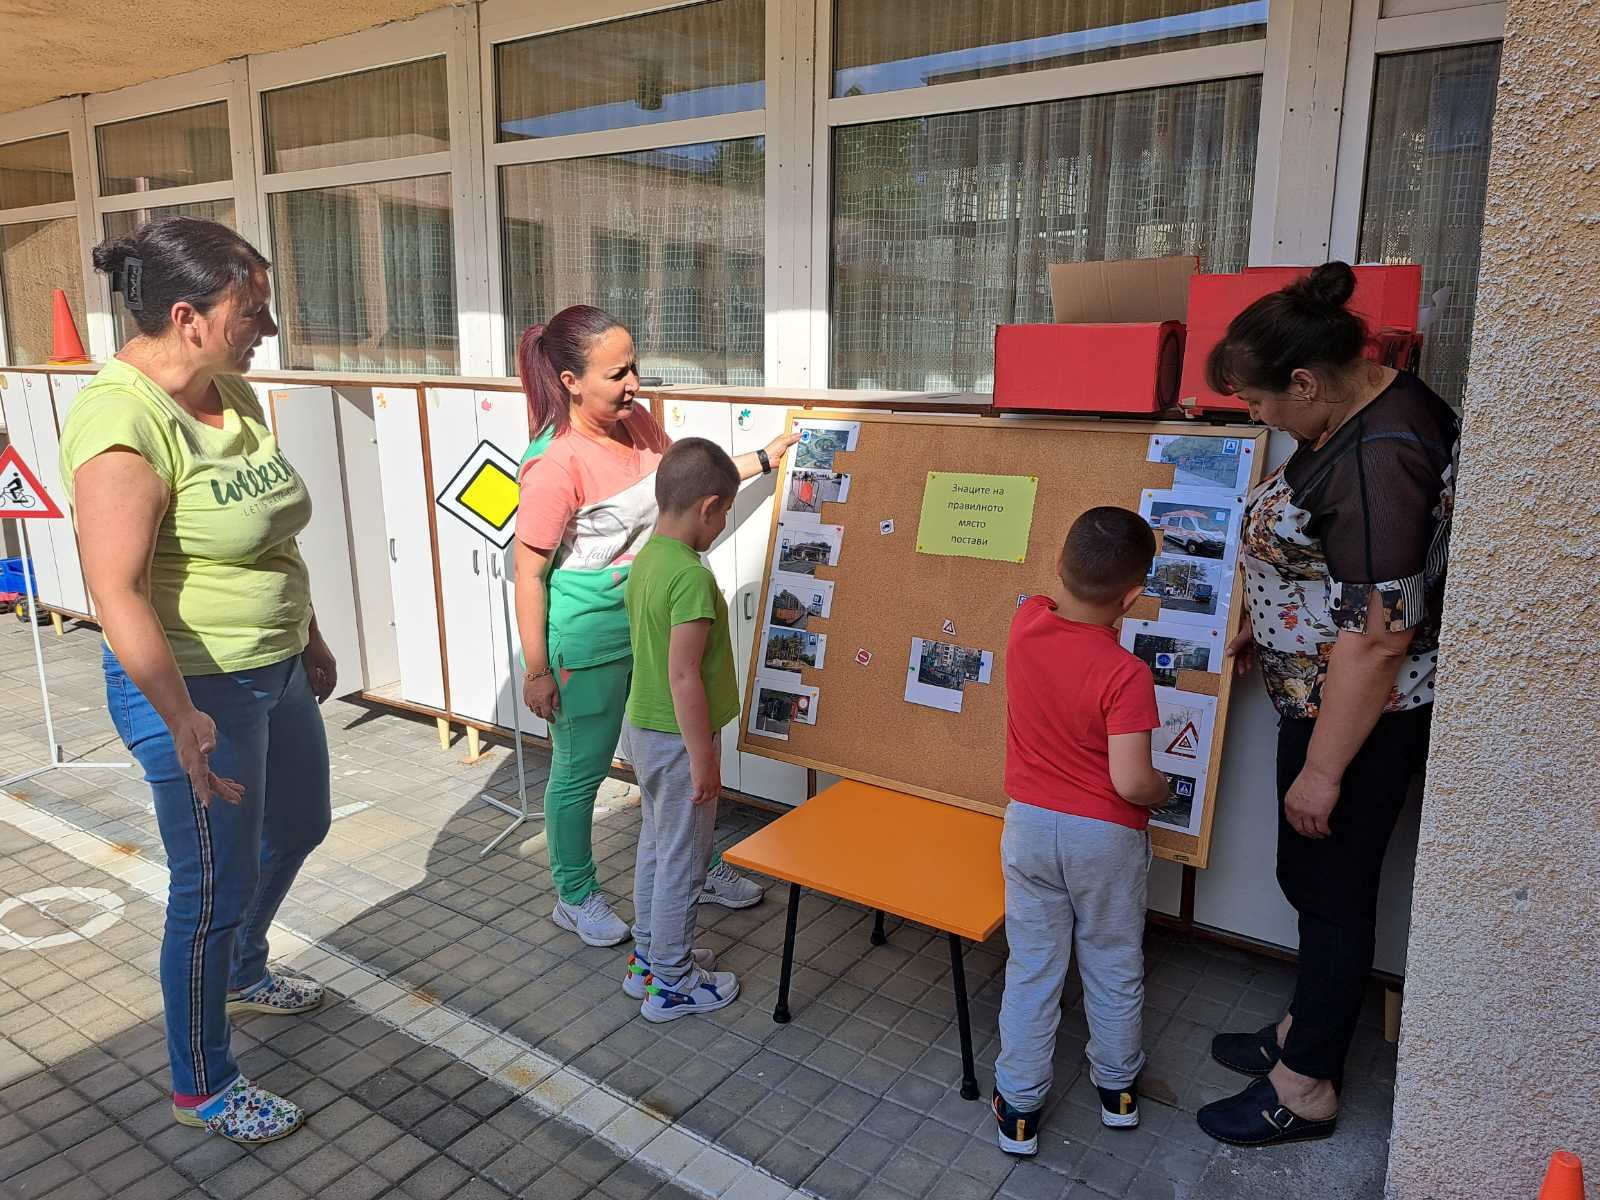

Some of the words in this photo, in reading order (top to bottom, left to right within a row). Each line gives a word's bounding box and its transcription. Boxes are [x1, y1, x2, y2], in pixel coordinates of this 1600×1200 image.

[951, 483, 991, 496] Знаците
[992, 487, 1005, 496] на
[947, 501, 1004, 513] правилното
[958, 519, 986, 529] място
[951, 535, 988, 546] постави
